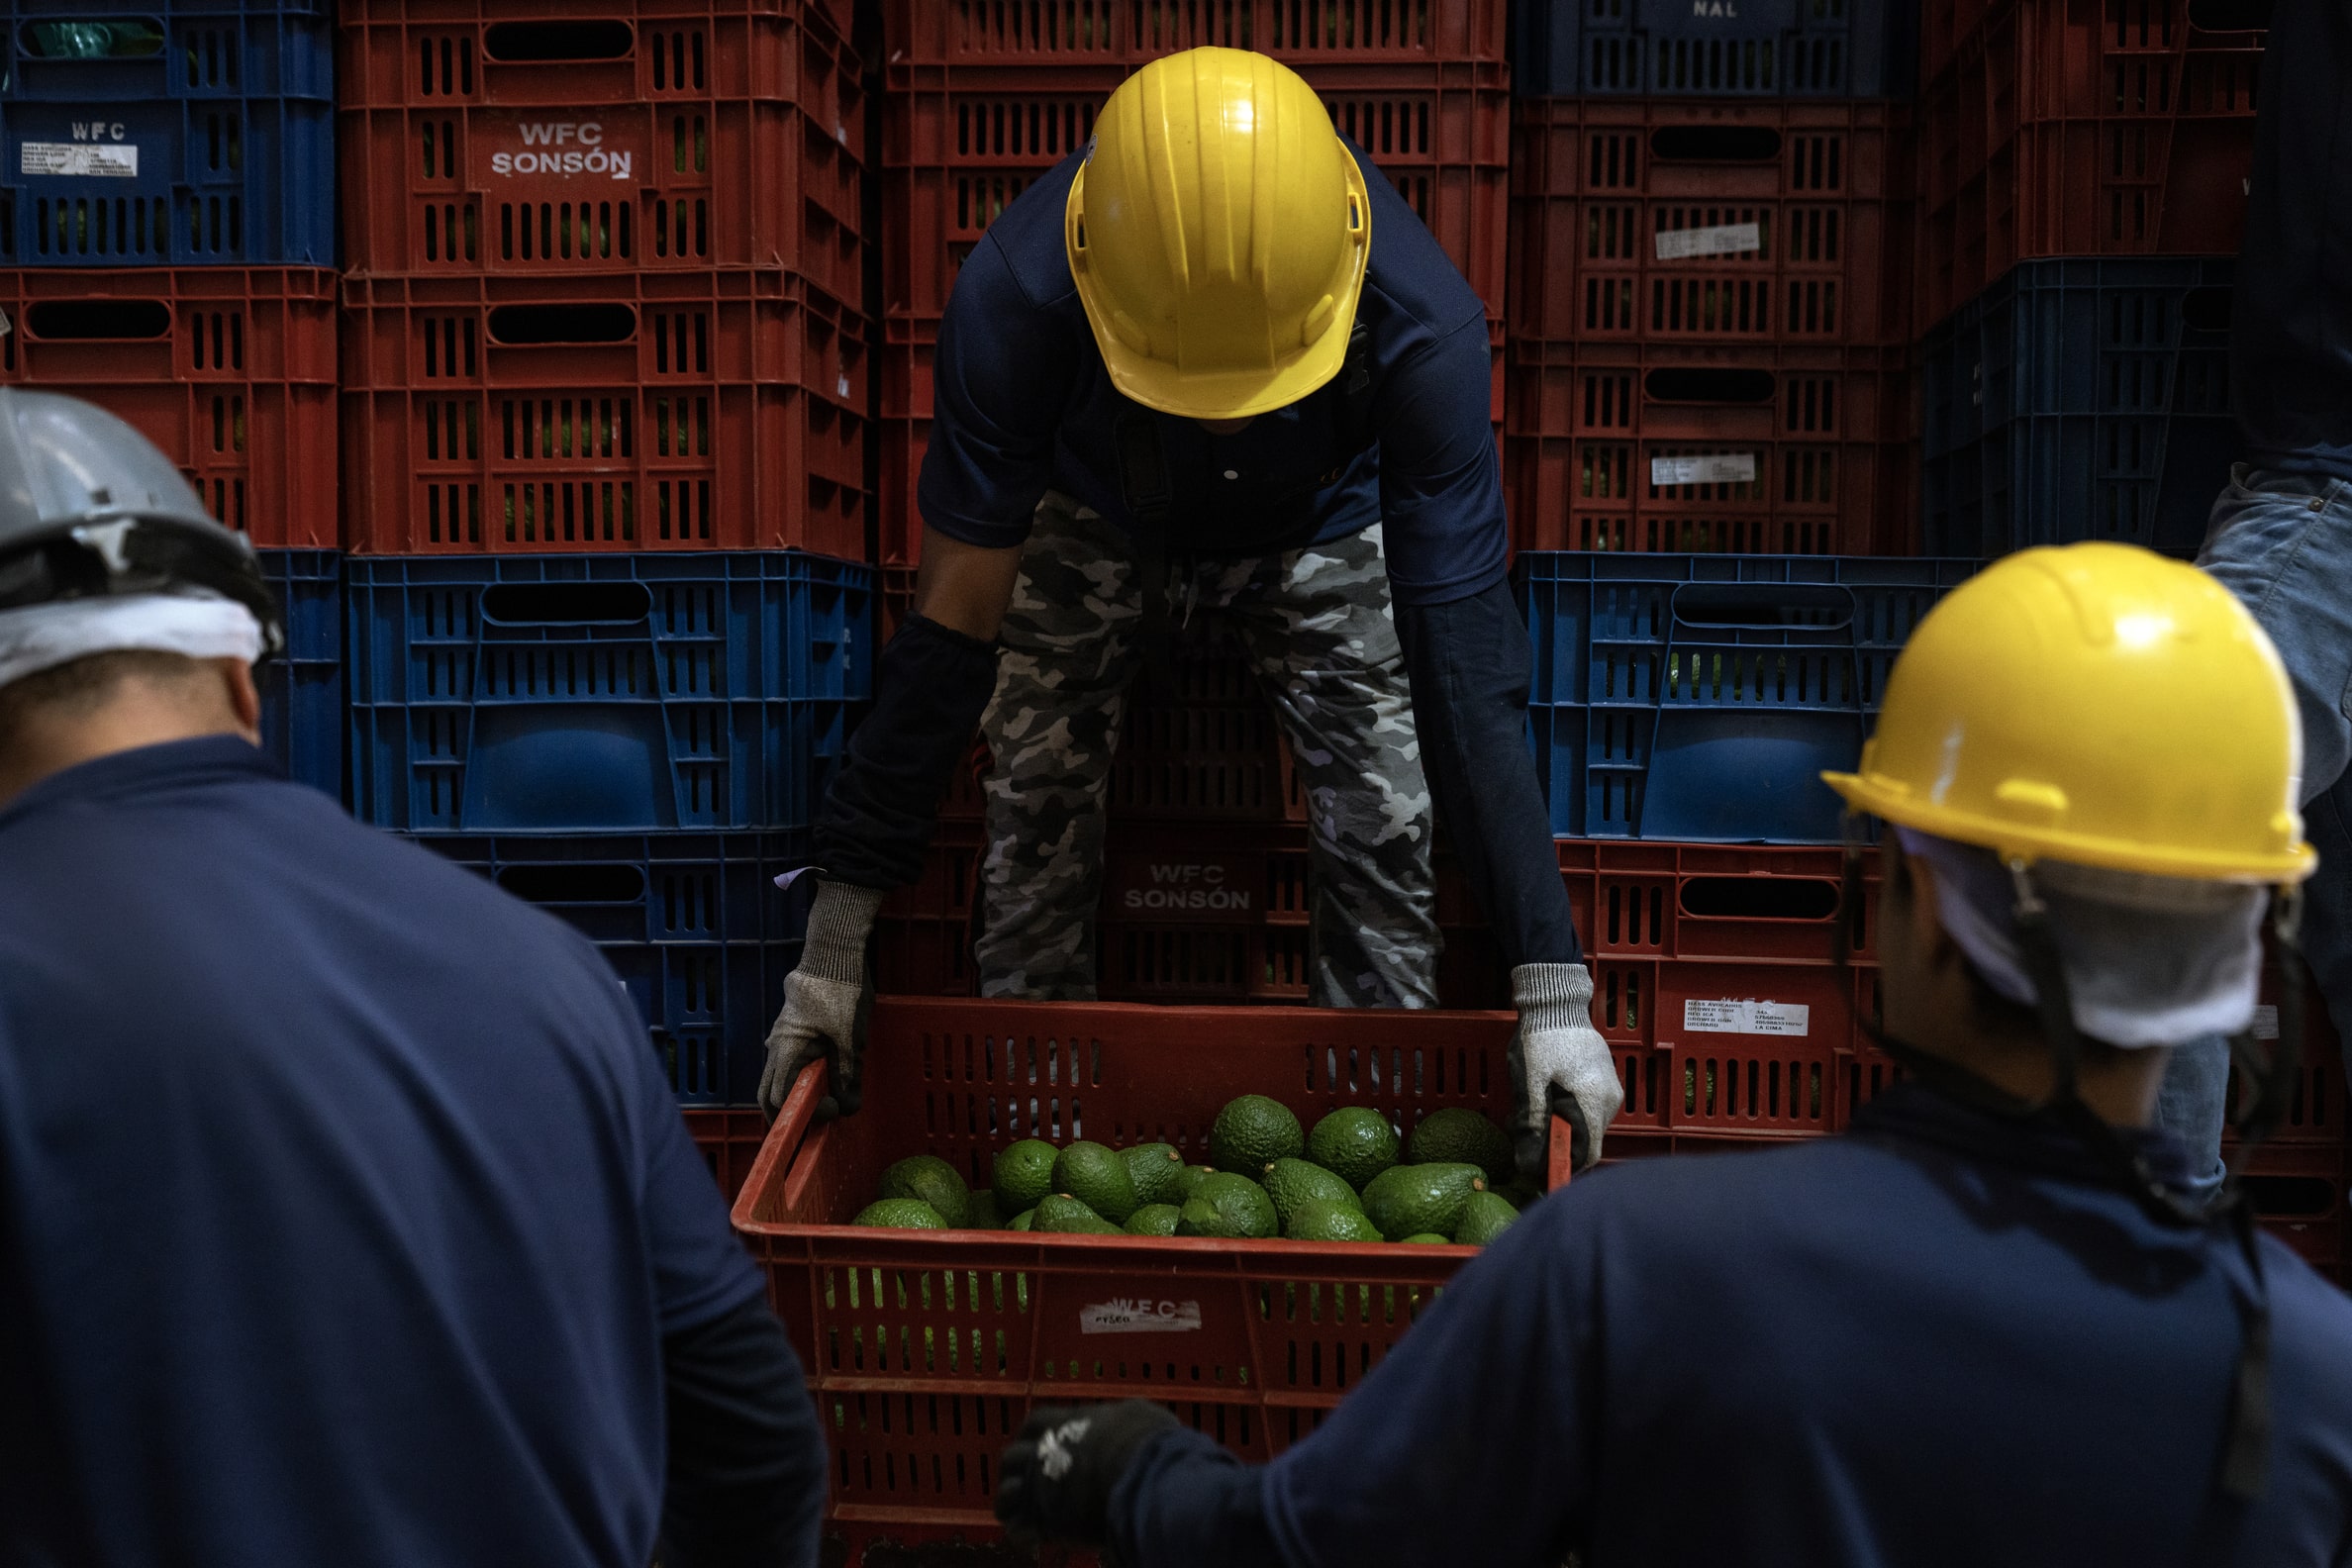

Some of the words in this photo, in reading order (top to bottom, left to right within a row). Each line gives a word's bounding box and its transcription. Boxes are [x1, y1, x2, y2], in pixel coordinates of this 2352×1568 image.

[1693, 0, 1738, 18] NAL
[71, 121, 125, 141] WFC
[519, 122, 603, 146] WFC
[491, 146, 632, 174] SONSÓN
[1149, 864, 1225, 883] WFC
[1125, 885, 1250, 910] SONSÓN
